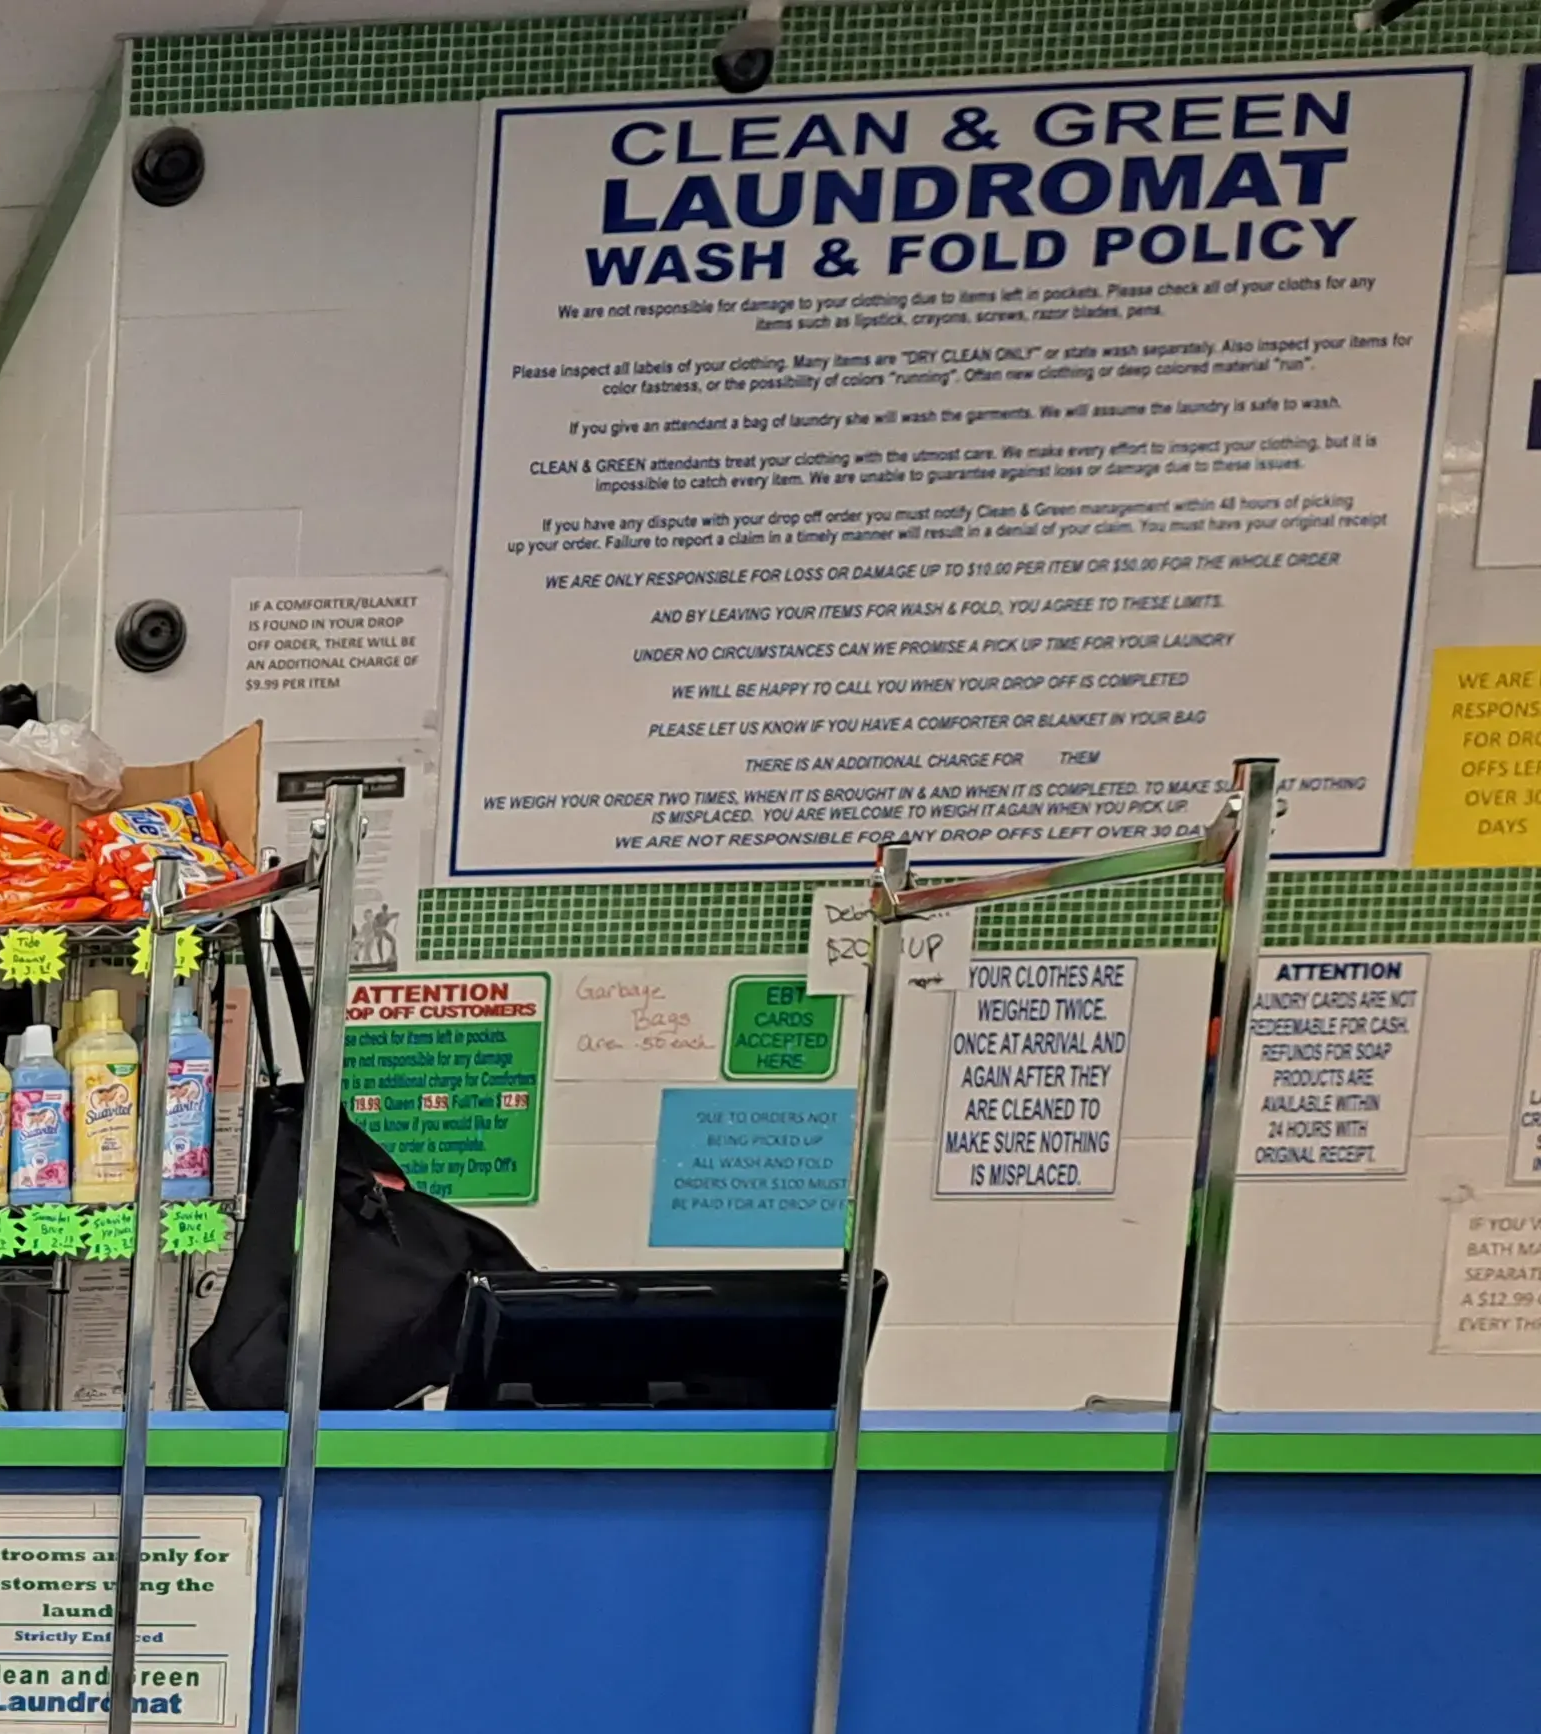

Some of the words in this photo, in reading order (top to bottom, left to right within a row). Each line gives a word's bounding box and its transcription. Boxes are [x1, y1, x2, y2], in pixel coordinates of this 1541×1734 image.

[610, 109, 908, 166] CLEAN
[941, 105, 1000, 152] &
[1033, 90, 1351, 147] GREEN
[601, 147, 1349, 234] LAUNDROMAT
[584, 239, 785, 287] WASH
[812, 237, 860, 278] &
[887, 228, 1067, 275] FOLD
[1092, 216, 1357, 267] POLICY
[249, 600, 261, 611] IF
[262, 600, 274, 611] A
[275, 595, 418, 611] COMFORTER/BLANKET
[248, 619, 260, 632] IS
[262, 618, 308, 632] FOUND
[311, 618, 325, 630] IN
[328, 617, 365, 629] YOUR
[367, 616, 404, 628] DROP
[247, 639, 270, 651] OFF
[324, 636, 363, 649] THERE
[366, 635, 398, 648] WILL
[400, 635, 416, 647] BE
[245, 659, 265, 671] AN
[267, 657, 346, 670] ADDITIONAL
[348, 655, 400, 668] CHARGE
[403, 654, 419, 667] OF
[245, 678, 279, 691] $9.99
[282, 677, 305, 690] PER
[308, 677, 340, 689] ITEM
[1459, 673, 1490, 689] WE
[1496, 671, 1533, 688] ARE
[1463, 732, 1501, 748] FOR
[746, 757, 794, 772] THERE
[795, 756, 810, 771] IS
[812, 756, 834, 771] AN
[836, 752, 923, 771] ADDITIONAL
[926, 753, 992, 768] CHARGE
[994, 751, 1024, 767] FOR
[1060, 750, 1101, 765] THEM
[1461, 761, 1508, 777] OFFS
[1465, 790, 1517, 806] OVER
[1478, 818, 1527, 835] DAYS
[968, 965, 1012, 988] YOUR
[1015, 964, 1088, 988] CLOTHES
[1090, 964, 1125, 987] ARE
[1275, 962, 1402, 981] ATTENTION
[352, 983, 509, 1004] ATTENTION
[767, 987, 805, 1005] EBT
[1254, 992, 1310, 1010] AUNDRY
[1310, 991, 1357, 1009] CARDS
[1358, 991, 1387, 1008] ARE
[1388, 990, 1418, 1007] NOT
[346, 1008, 374, 1020] OP
[380, 1007, 414, 1019] OFF
[420, 1003, 536, 1018] CUSTOMERS
[977, 998, 1050, 1022] WEIGHED
[1054, 997, 1107, 1021] TWICE.
[755, 1013, 813, 1025] CARDS
[1249, 1017, 1338, 1036] REDEEMABLE
[1339, 1017, 1367, 1035] FOR
[735, 1033, 828, 1047] ACCEPTED
[953, 1031, 998, 1055] ONCE
[999, 1031, 1021, 1055] AT
[1021, 1031, 1089, 1055] ARRIVAL
[1090, 1031, 1127, 1054] AND
[757, 1054, 804, 1068] HERE
[1260, 1044, 1322, 1061] REFUNDS
[1324, 1043, 1353, 1060] FOR
[1354, 1043, 1392, 1060] SOAP
[960, 1065, 1011, 1088] AGAIN
[1013, 1064, 1065, 1088] AFTER
[1069, 1064, 1111, 1087] THEY
[1272, 1069, 1345, 1087] PRODUCTS
[1345, 1068, 1374, 1086] ARE
[86, 1103, 133, 1125] Suavitel
[166, 1099, 203, 1116] uavitel
[964, 1097, 998, 1121] ARE
[1001, 1097, 1075, 1121] CLEANED
[1079, 1097, 1100, 1120] TO
[19, 1123, 59, 1141] Suavitel
[1267, 1121, 1283, 1138] 24
[1285, 1120, 1332, 1138] HOURS
[1334, 1120, 1368, 1137] WITH
[945, 1131, 990, 1153] MAKE
[993, 1130, 1037, 1153] SURE
[1039, 1130, 1110, 1153] NOTHING
[1255, 1146, 1314, 1163] ORIGINAL
[970, 1163, 985, 1186] IS
[988, 1163, 1081, 1186] MISPLACED.
[140, 1548, 188, 1566] only
[194, 1549, 229, 1562] for
[177, 1578, 214, 1592] the
[42, 1604, 113, 1618] laund
[15, 1631, 78, 1644] Strictly
[82, 1631, 163, 1643] Enfced
[62, 1666, 110, 1685] and
[132, 1668, 199, 1686] reen
